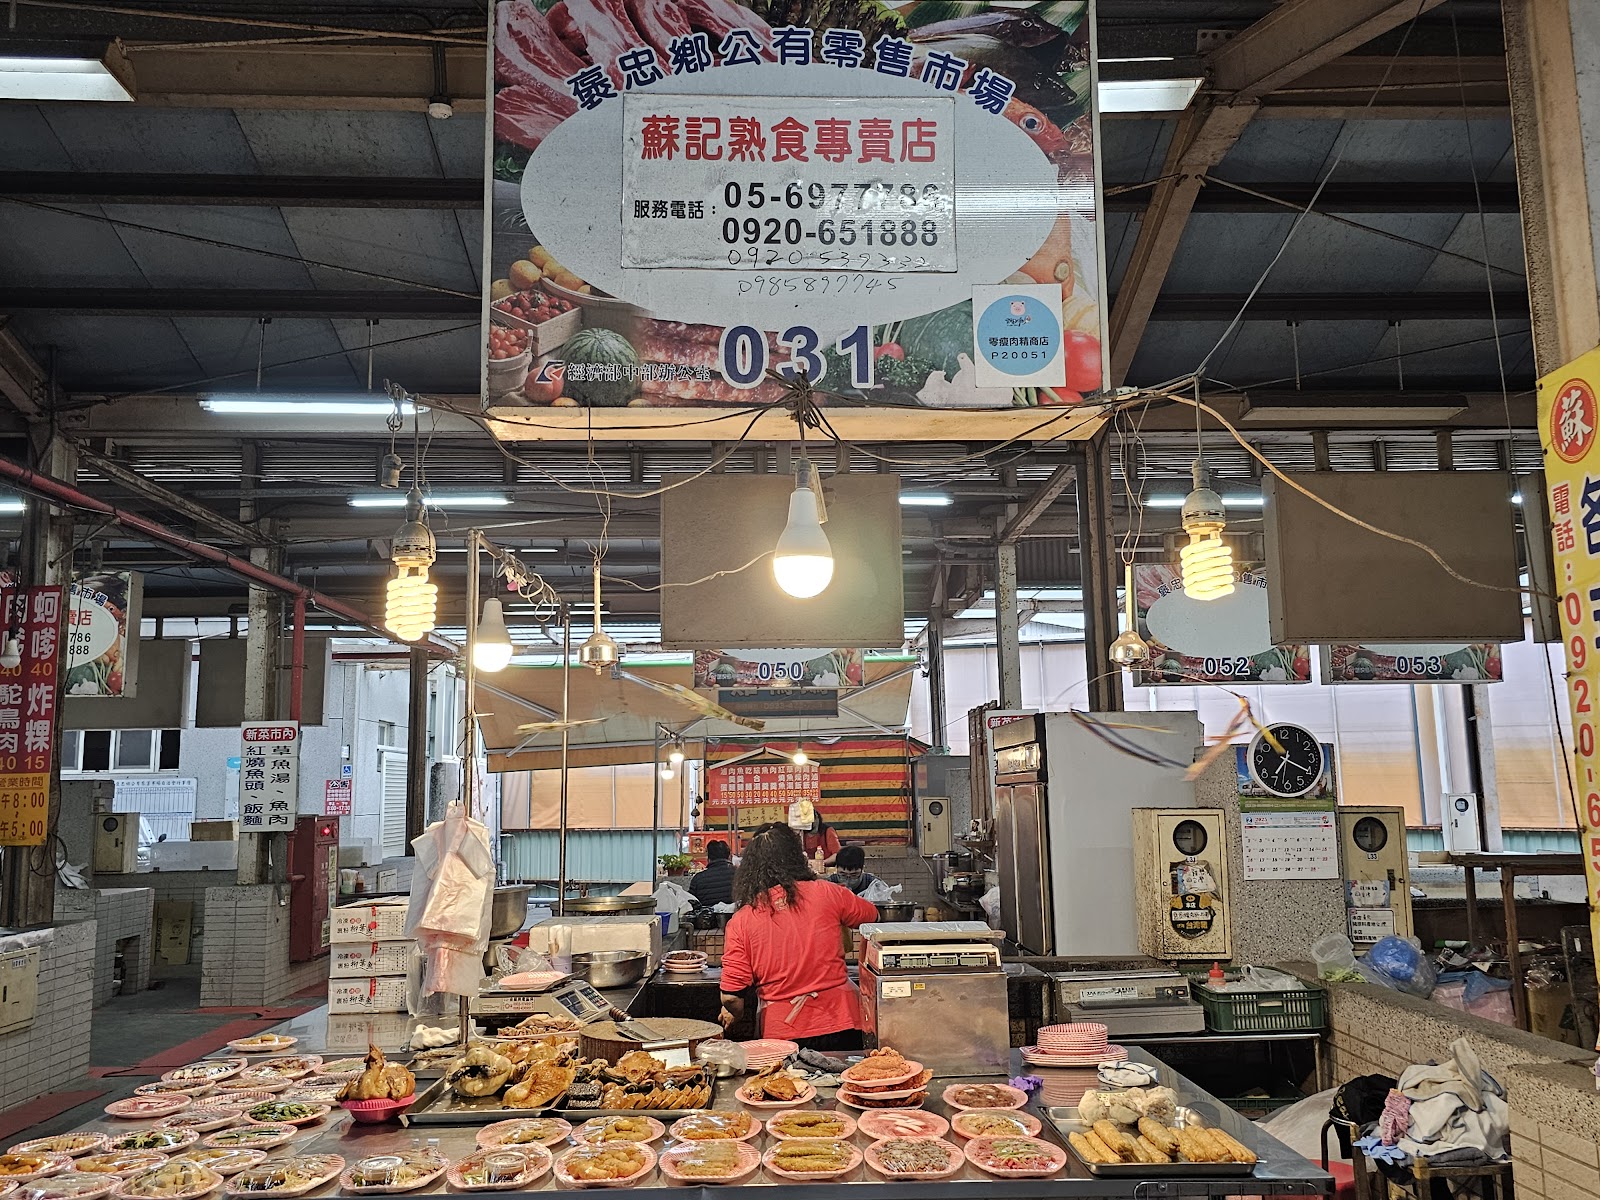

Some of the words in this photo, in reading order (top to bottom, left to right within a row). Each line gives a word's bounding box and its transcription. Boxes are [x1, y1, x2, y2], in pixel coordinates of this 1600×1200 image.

[567, 27, 1014, 114] 褒忠鄉公有零售市場
[641, 114, 937, 164] 蘇記熟食專賣店
[722, 217, 938, 246] 0920-651888
[989, 336, 1048, 346] 零瘦肉精商店
[721, 324, 873, 387] 031
[992, 351, 1046, 359] P20051
[1559, 389, 1593, 453] 蘇
[31, 663, 52, 676] 40
[759, 662, 803, 681] 050
[1204, 657, 1250, 675] 052
[1397, 656, 1441, 674] 053
[24, 682, 54, 753] 炸粿
[246, 726, 294, 741] 新菜市內
[1280, 730, 1289, 739] 12
[1303, 741, 1311, 750] 2
[24, 756, 45, 769] 15
[1256, 755, 1263, 765] 9
[1308, 753, 1315, 763] 3
[1261, 768, 1268, 778] 8
[1271, 776, 1278, 786] 7
[1284, 780, 1291, 790] 6
[1297, 776, 1304, 786] 5
